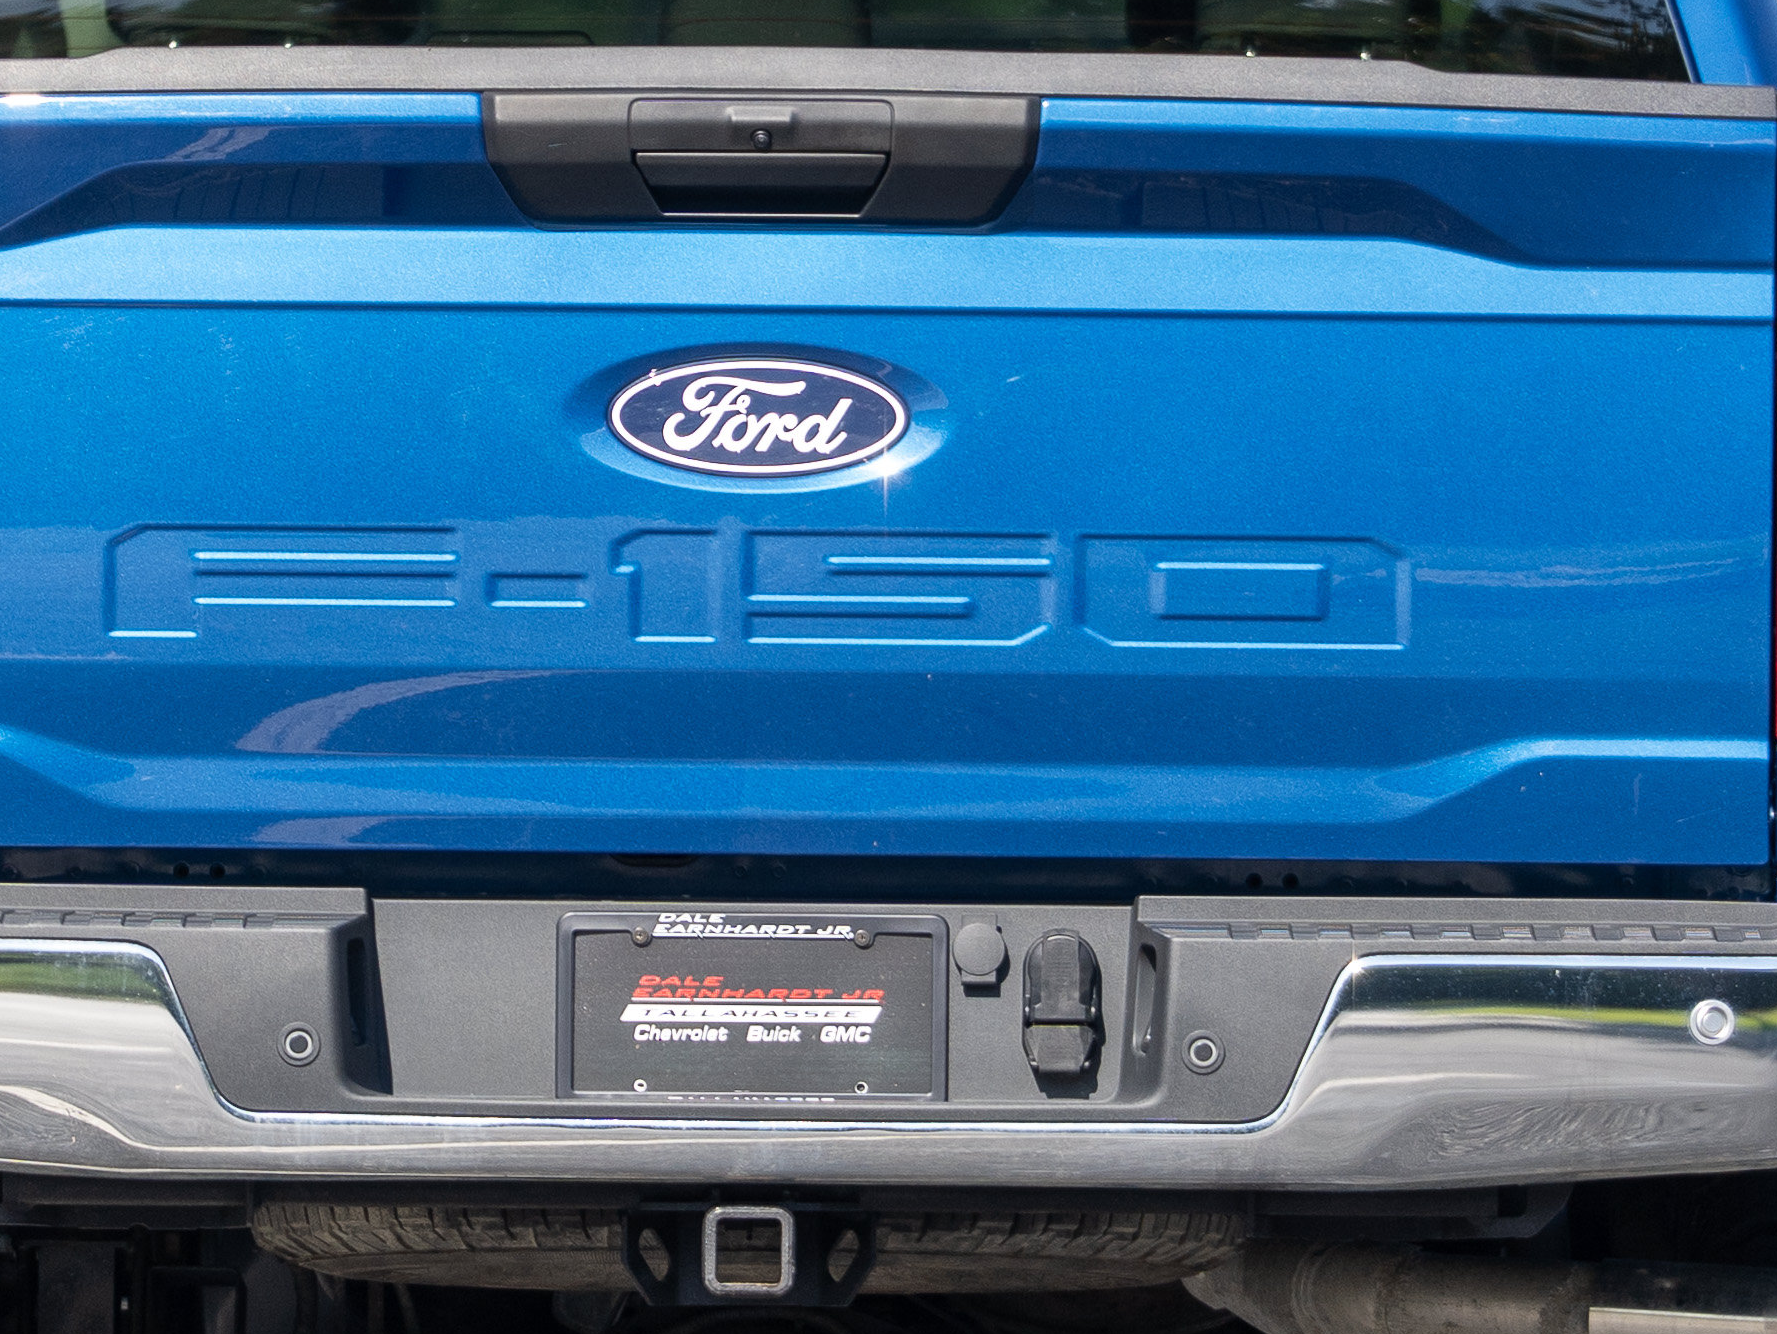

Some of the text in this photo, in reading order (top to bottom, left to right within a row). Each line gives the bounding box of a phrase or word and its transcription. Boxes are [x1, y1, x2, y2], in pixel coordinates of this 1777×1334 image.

[662, 376, 853, 454] Ford
[106, 523, 1412, 651] F-150
[658, 913, 726, 923] DALE
[653, 924, 811, 937] EARNHARDT
[638, 975, 724, 987] DALE
[632, 987, 886, 1003] EARNHARDT JR
[643, 1007, 862, 1018] TALLAHASSEE
[633, 1023, 872, 1044] Chevrolet Buick GMC
